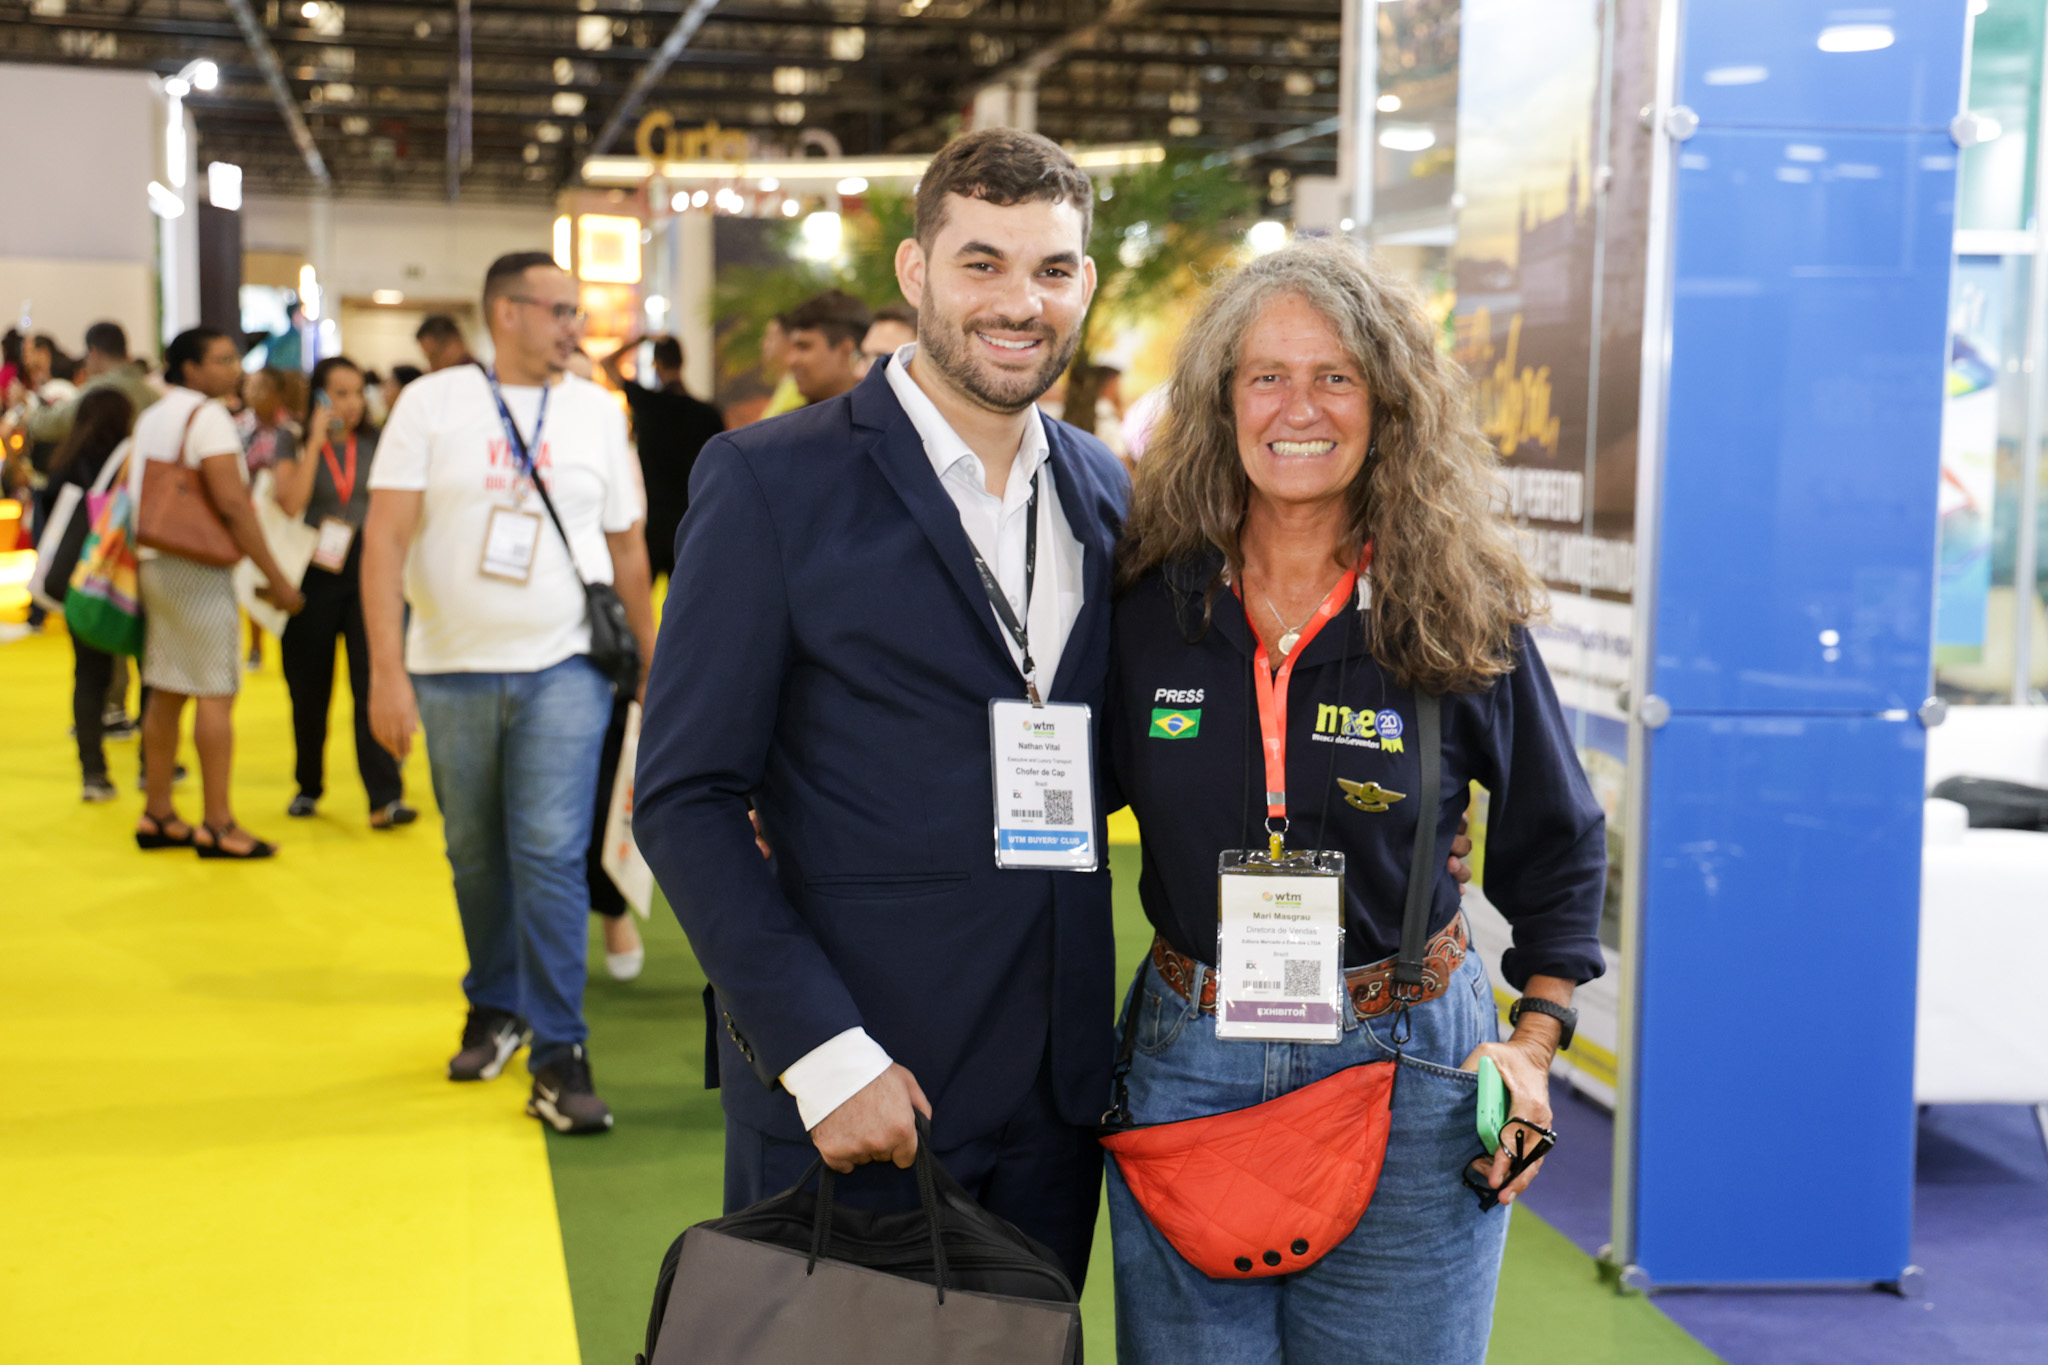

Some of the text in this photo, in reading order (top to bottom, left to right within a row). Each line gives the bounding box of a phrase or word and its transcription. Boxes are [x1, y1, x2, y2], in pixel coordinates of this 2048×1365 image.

[1154, 688, 1205, 703] PRESS
[1315, 703, 1377, 738] m&e
[1380, 715, 1397, 729] 20
[1033, 721, 1055, 731] wtm
[1018, 742, 1061, 751] Nathan Vital
[1016, 767, 1066, 778] Chofer de Cap
[1008, 835, 1026, 844] WTM
[1060, 837, 1080, 846] CLUB
[1275, 892, 1302, 901] wtm
[1274, 913, 1311, 922] Masgrau
[1246, 926, 1276, 934] Diretora
[1289, 927, 1318, 935] Vendas
[1257, 1007, 1306, 1017] EXHIBITOR
